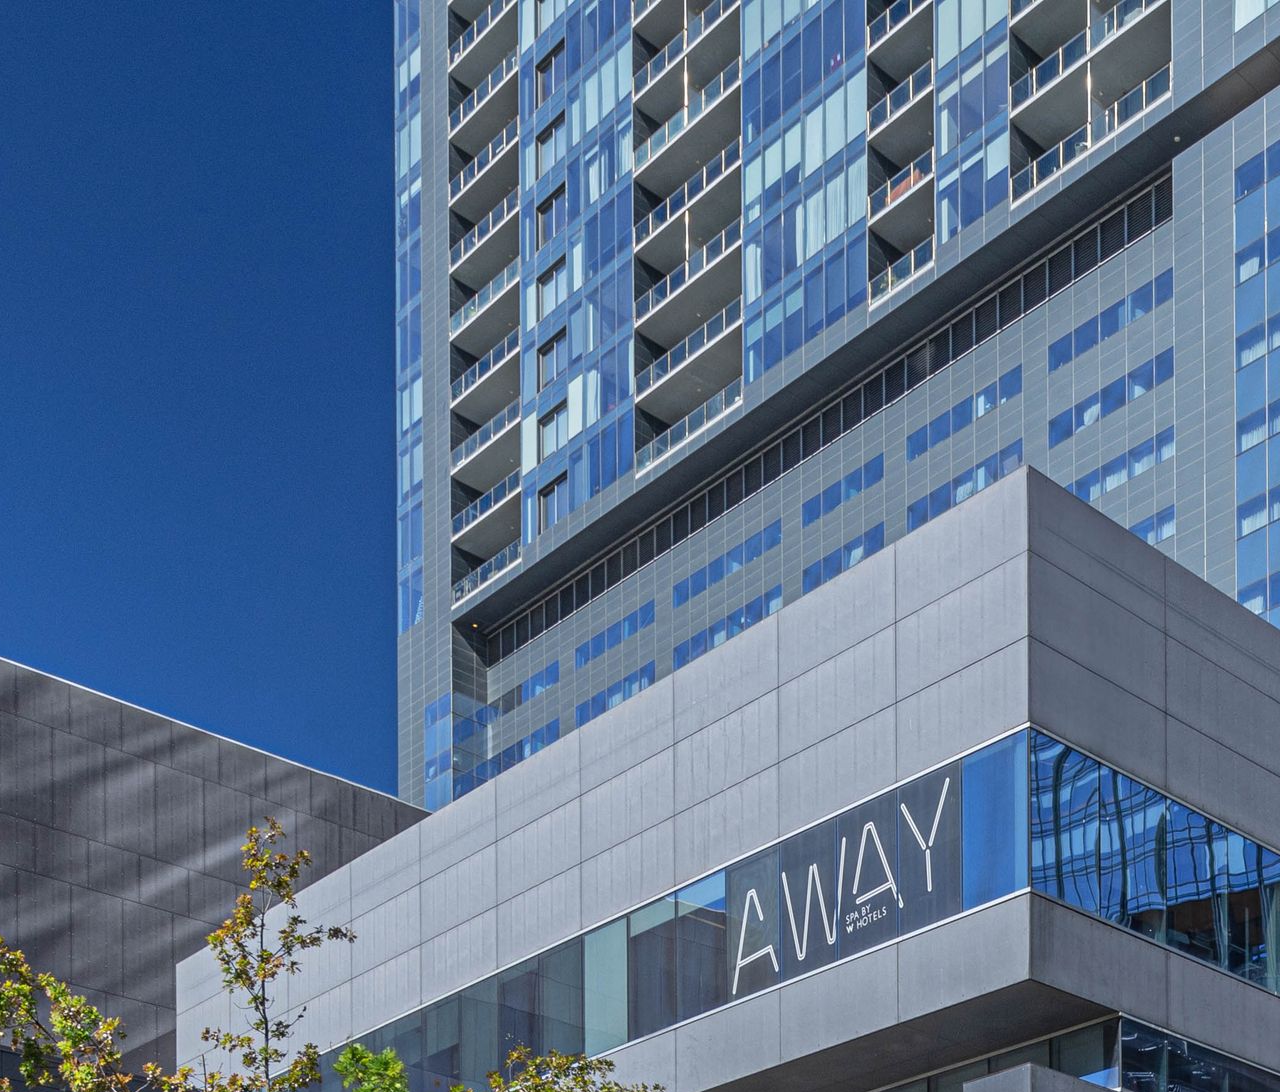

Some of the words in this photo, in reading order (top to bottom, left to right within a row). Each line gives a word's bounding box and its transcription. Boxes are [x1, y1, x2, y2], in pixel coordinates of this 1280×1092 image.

[731, 777, 950, 995] AWAY
[845, 910, 859, 924] SPA
[861, 903, 871, 916] BY
[845, 923, 854, 934] W
[856, 906, 887, 929] HOTELS
